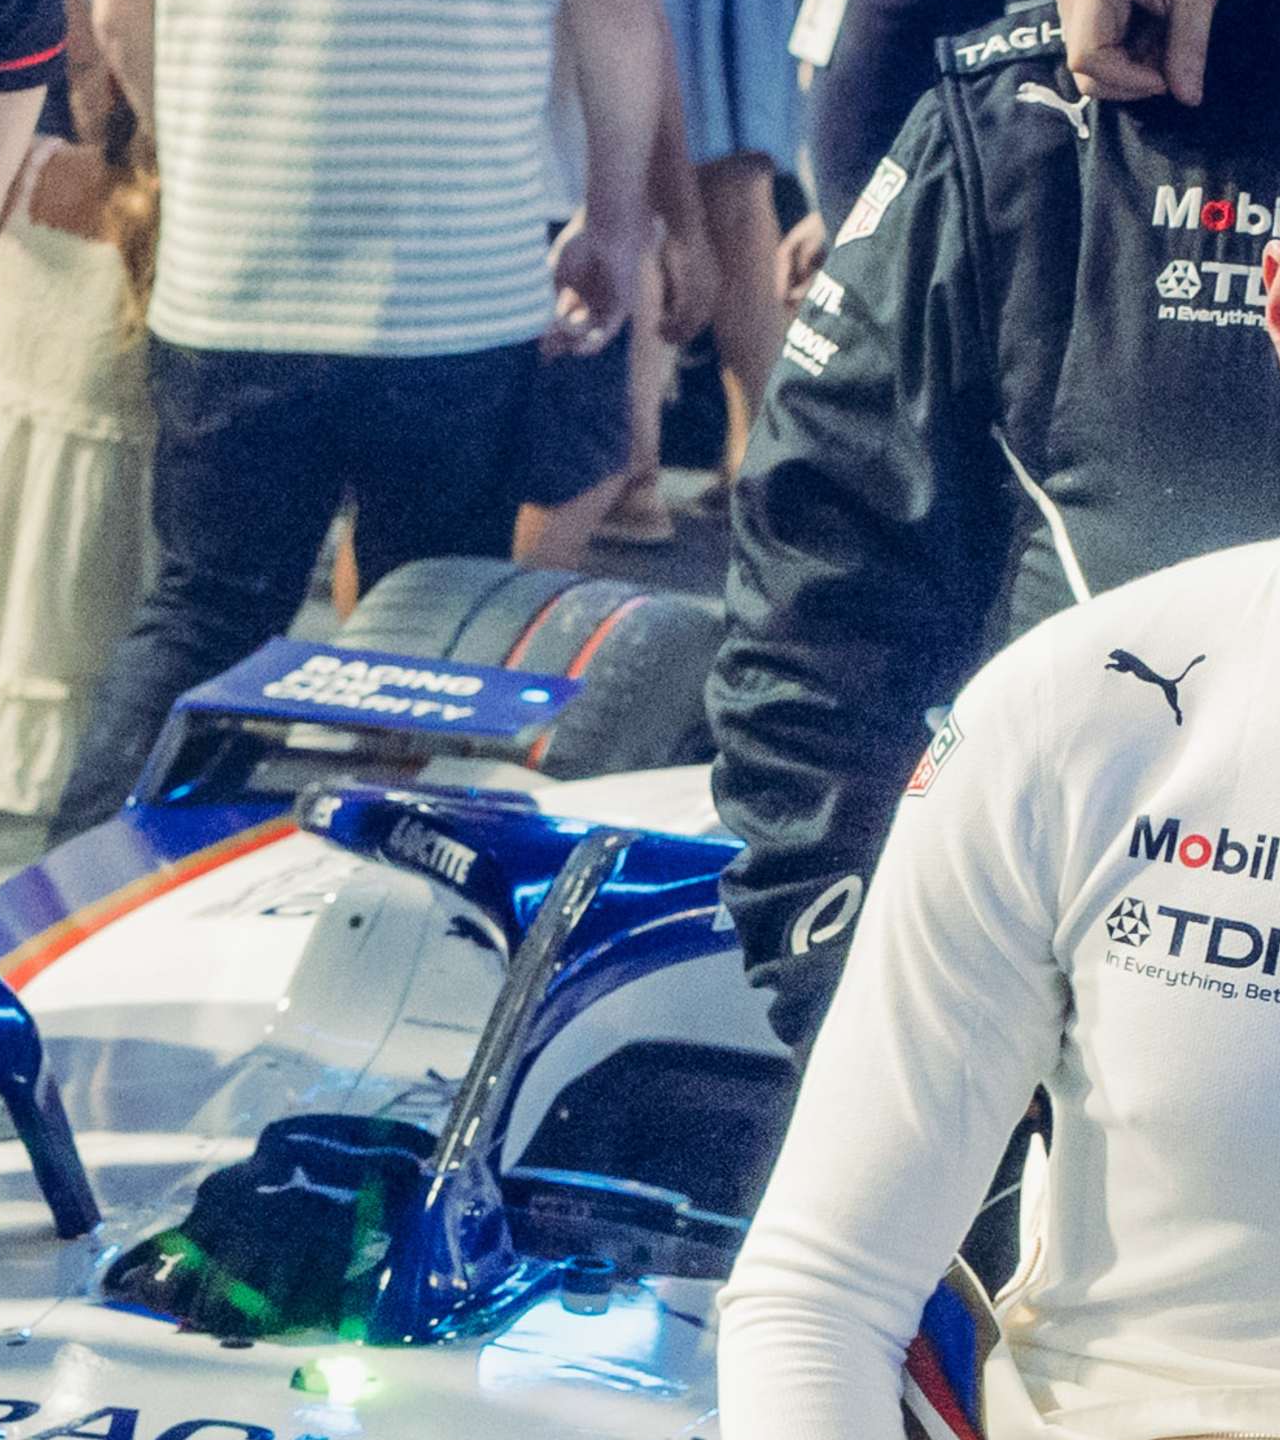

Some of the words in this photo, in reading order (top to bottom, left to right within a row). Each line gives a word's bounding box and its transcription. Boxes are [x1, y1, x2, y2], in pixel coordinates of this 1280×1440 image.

[1128, 814, 1280, 881] Mobil
[1104, 950, 1121, 968] In
[1123, 958, 1240, 999] Everything,
